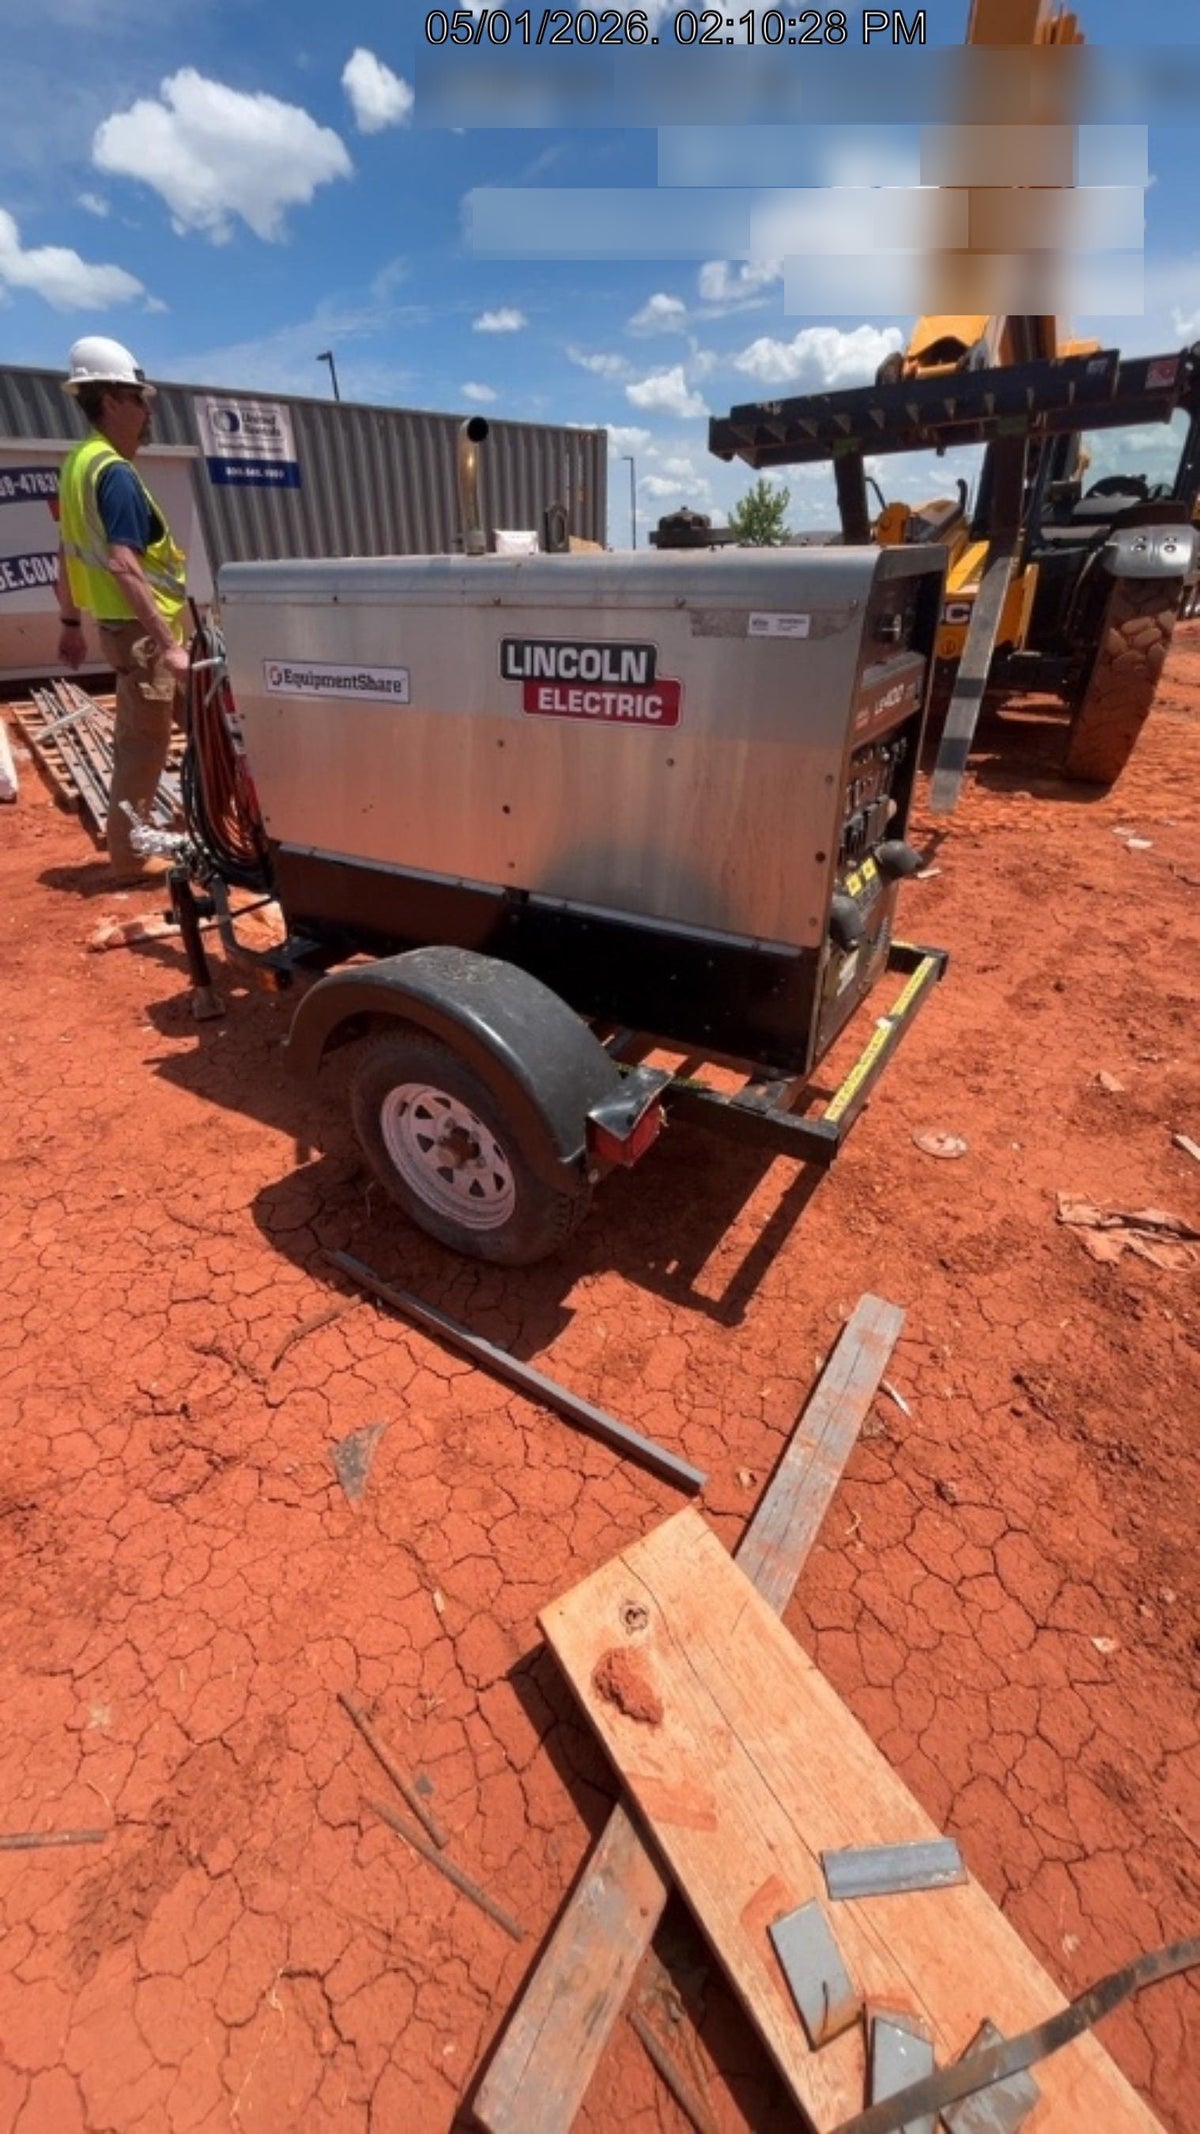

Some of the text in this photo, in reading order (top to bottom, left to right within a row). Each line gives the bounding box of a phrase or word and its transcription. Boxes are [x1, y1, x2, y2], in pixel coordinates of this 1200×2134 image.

[507, 644, 648, 683] LINCOLN
[283, 668, 402, 693] EquipmentShare
[538, 687, 662, 719] ELECTRIC
